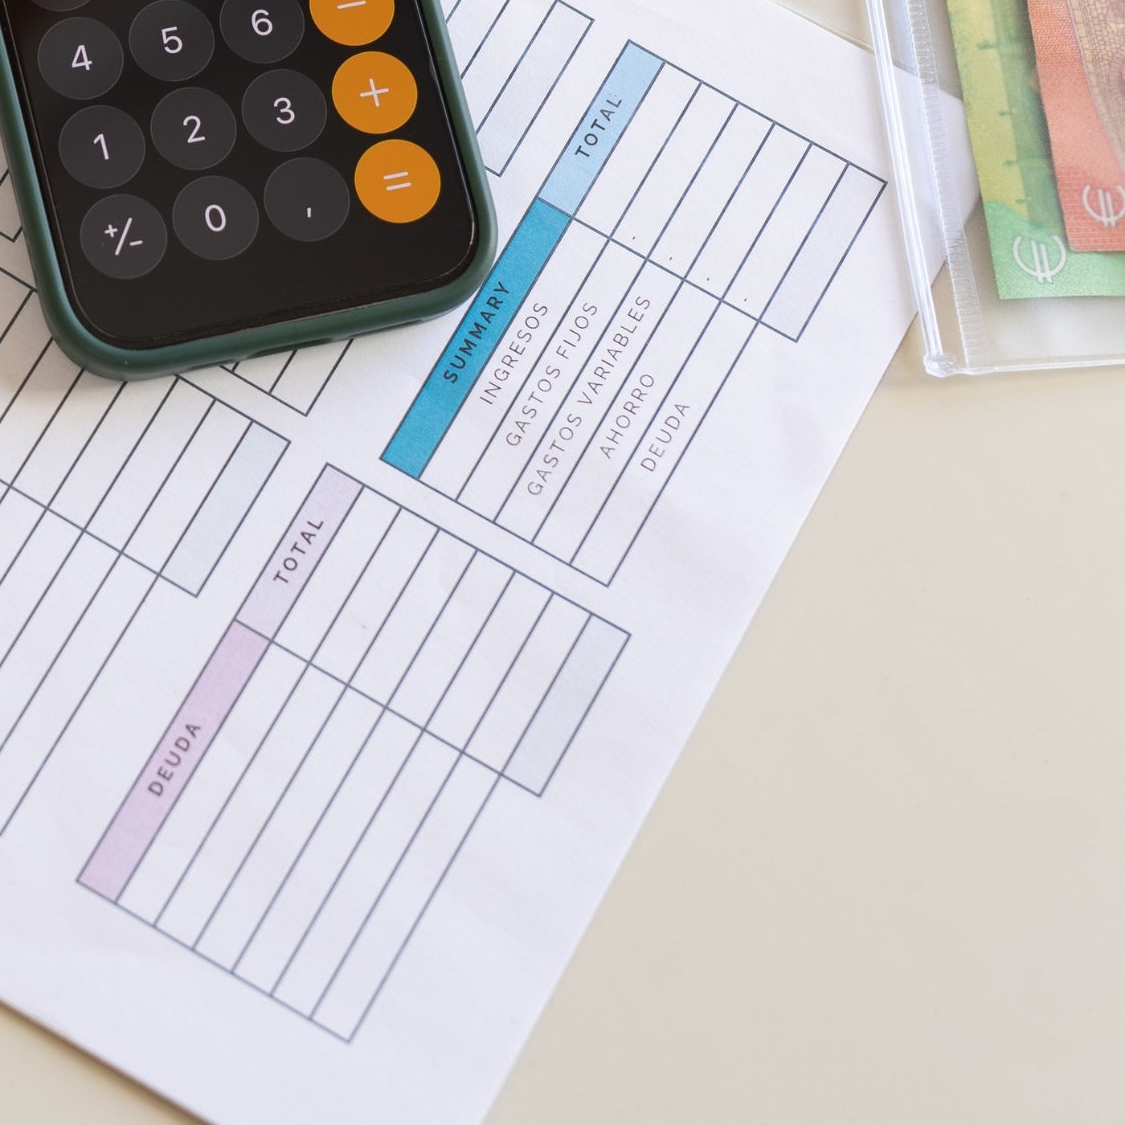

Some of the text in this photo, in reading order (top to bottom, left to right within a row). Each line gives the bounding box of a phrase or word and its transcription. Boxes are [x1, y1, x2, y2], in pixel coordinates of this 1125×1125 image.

[161, 26, 183, 54] 5
[251, 9, 273, 36] 6
[71, 44, 93, 71] 4
[182, 115, 206, 144] 2
[273, 97, 296, 125] 3
[574, 97, 623, 159] TOTAL
[93, 133, 110, 160] 1
[204, 204, 227, 232] 0
[443, 281, 511, 384] SUMMARY
[479, 301, 549, 406] INGRESOS
[505, 301, 598, 447] GASTOS FIJOS
[527, 296, 652, 497] GASTOS VARIABLES
[599, 373, 655, 460] AHORRO
[640, 401, 691, 473] DEUDA
[273, 518, 324, 585] TOTAL
[148, 722, 202, 797] DEUDA
